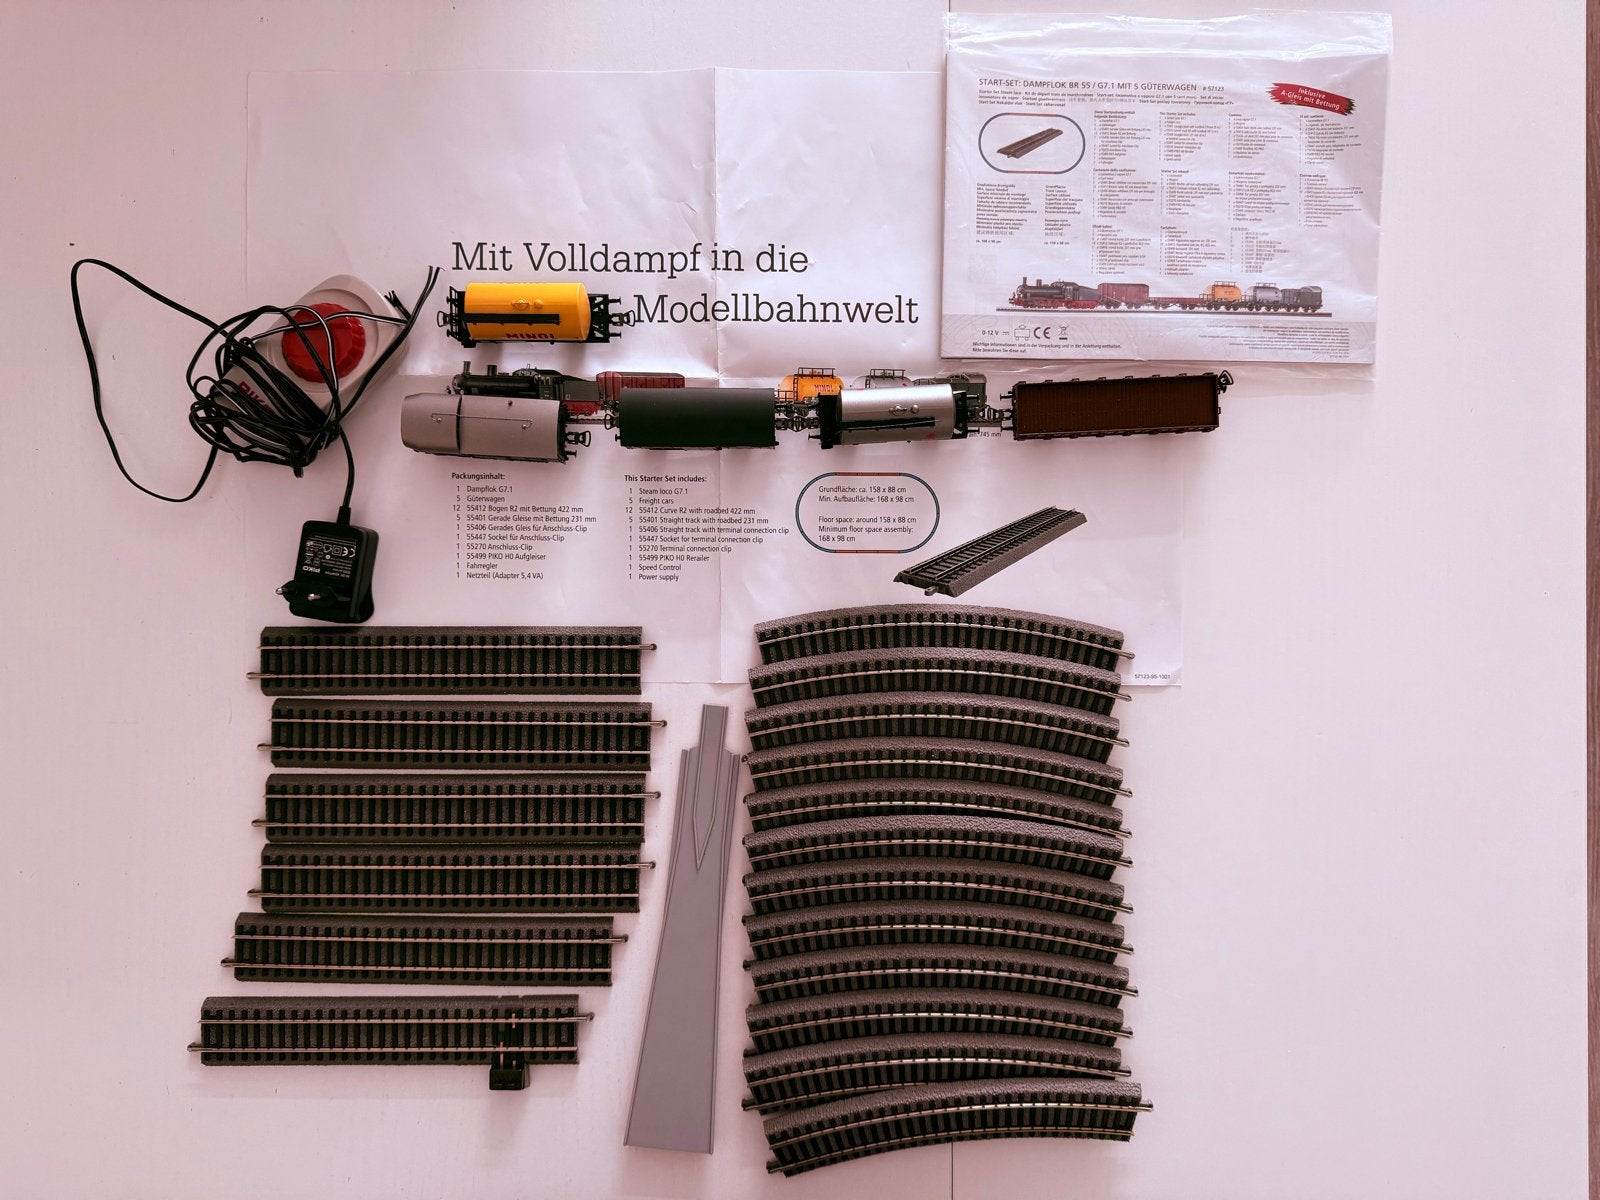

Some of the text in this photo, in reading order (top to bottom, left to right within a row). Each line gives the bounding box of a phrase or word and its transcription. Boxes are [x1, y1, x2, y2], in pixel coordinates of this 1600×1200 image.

[979, 79, 1021, 87] START-SET:
[1023, 80, 1066, 88] DAMPFLOK
[1141, 82, 1197, 91] GÜTERWAGEN
[1298, 88, 1326, 99] Inklusive
[1281, 90, 1302, 100] A-Gleis
[1316, 98, 1339, 110] Bettung
[452, 241, 809, 279] Mit Volldampf in die
[634, 293, 919, 323] Modellbahnwelt
[452, 472, 505, 480] Packungsinhalt:
[467, 486, 497, 494] Dampflok
[467, 495, 505, 503] Güterwagen
[639, 498, 660, 506] Freight
[532, 506, 556, 514] Bettung
[546, 516, 569, 524] Bettung
[660, 517, 684, 525] Straight
[543, 525, 587, 533] Anschluss-Clip
[660, 526, 684, 534] Straight
[778, 527, 789, 535] clip
[515, 554, 546, 562] Aufgleiser
[467, 562, 498, 570] Fahrregler
[639, 564, 658, 572] Speed
[492, 572, 519, 580] (Adapter
